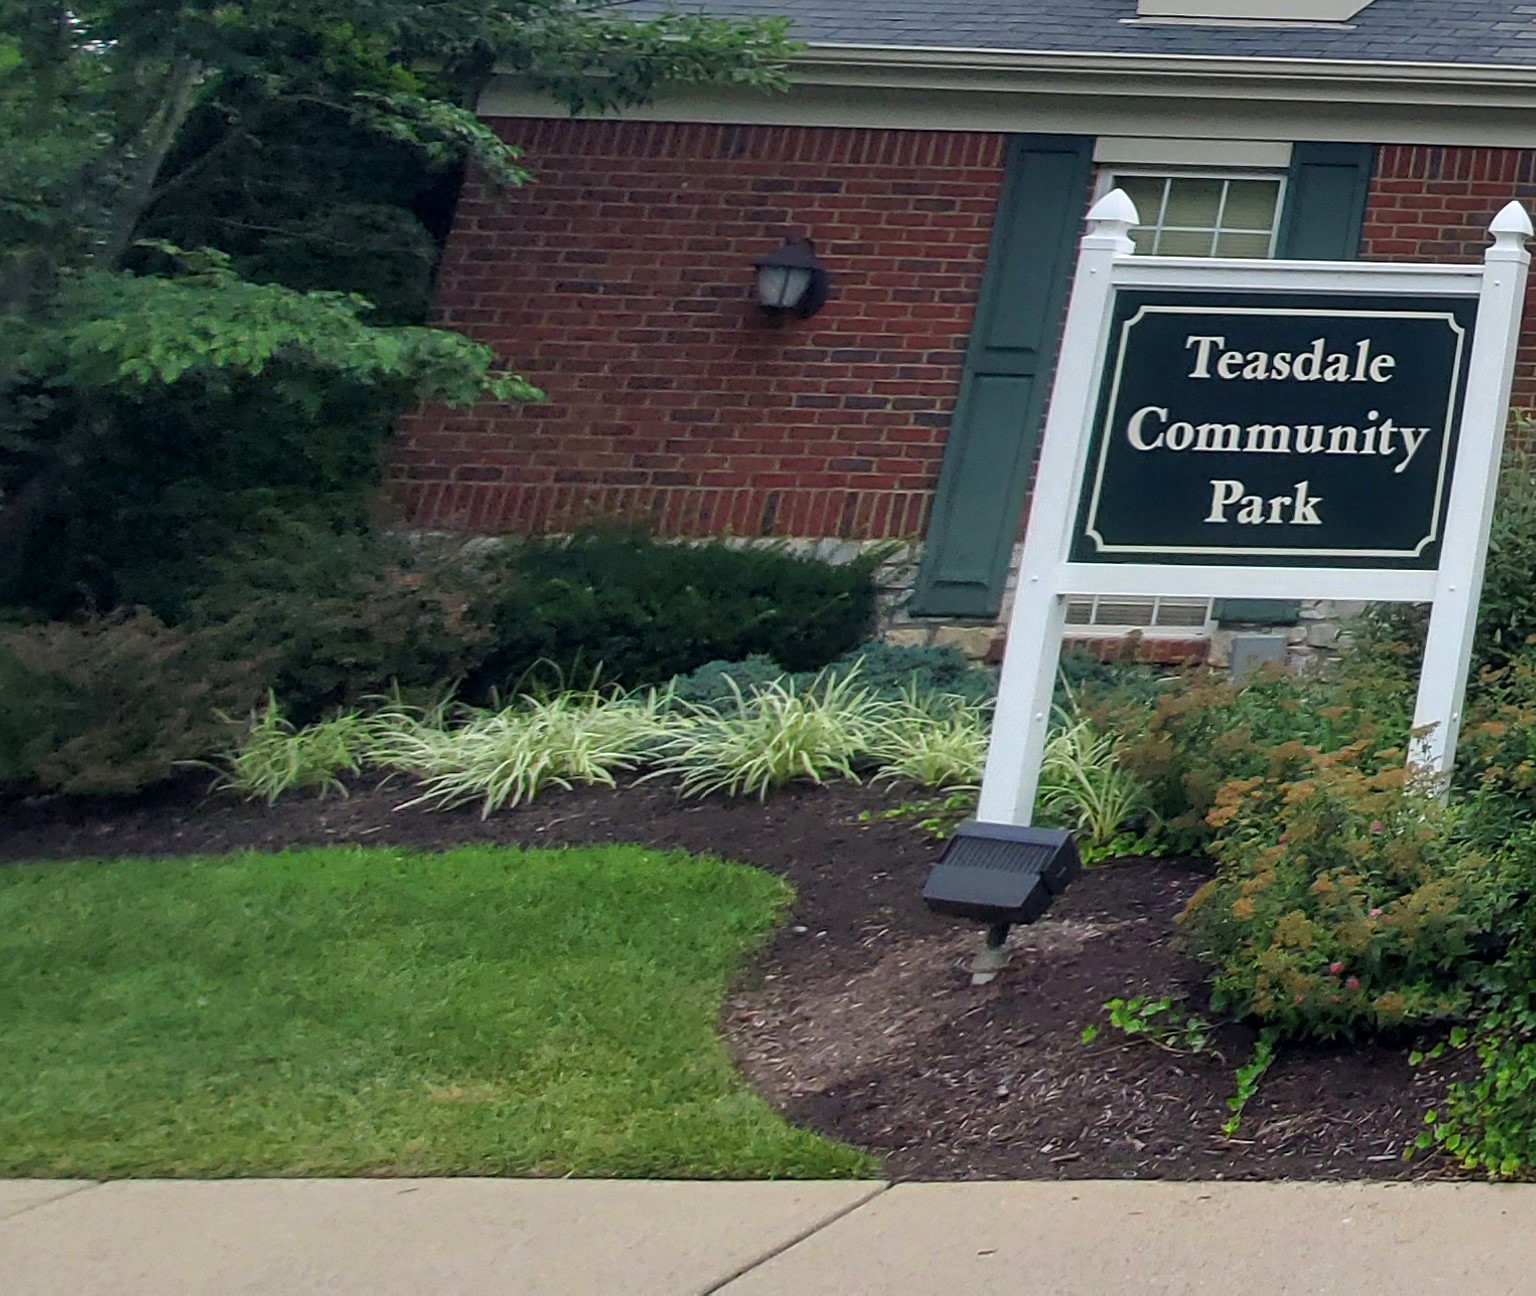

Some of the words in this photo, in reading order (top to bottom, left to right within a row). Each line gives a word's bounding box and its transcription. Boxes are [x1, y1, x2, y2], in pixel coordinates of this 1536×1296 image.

[1185, 335, 1396, 383] Teasdale
[1127, 406, 1431, 473] Community
[1203, 480, 1323, 525] Park
